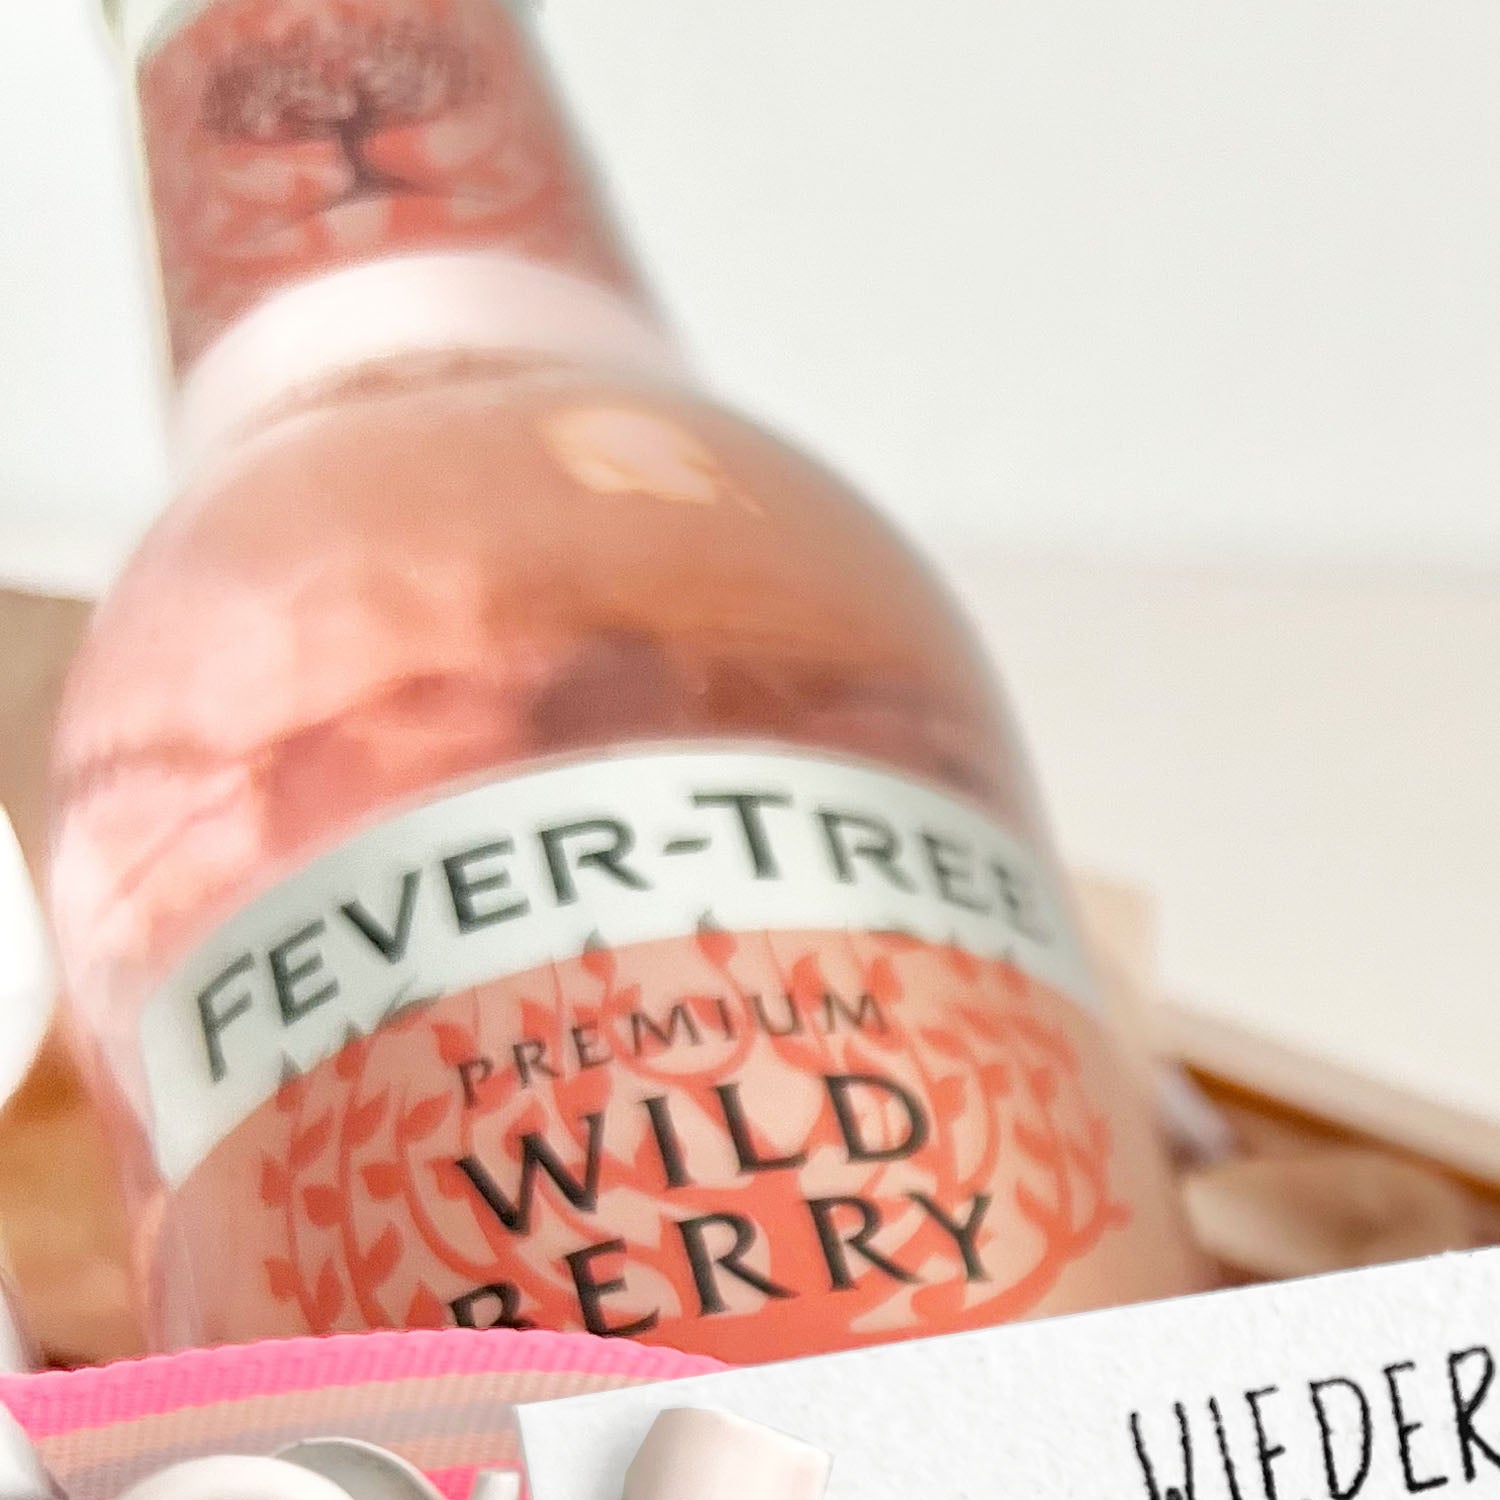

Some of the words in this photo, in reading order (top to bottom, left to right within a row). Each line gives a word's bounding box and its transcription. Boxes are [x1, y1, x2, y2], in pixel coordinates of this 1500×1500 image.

[196, 790, 1055, 1085] FEVER-TREE
[457, 992, 890, 1110] PREMIUM
[454, 1073, 930, 1237] WILD
